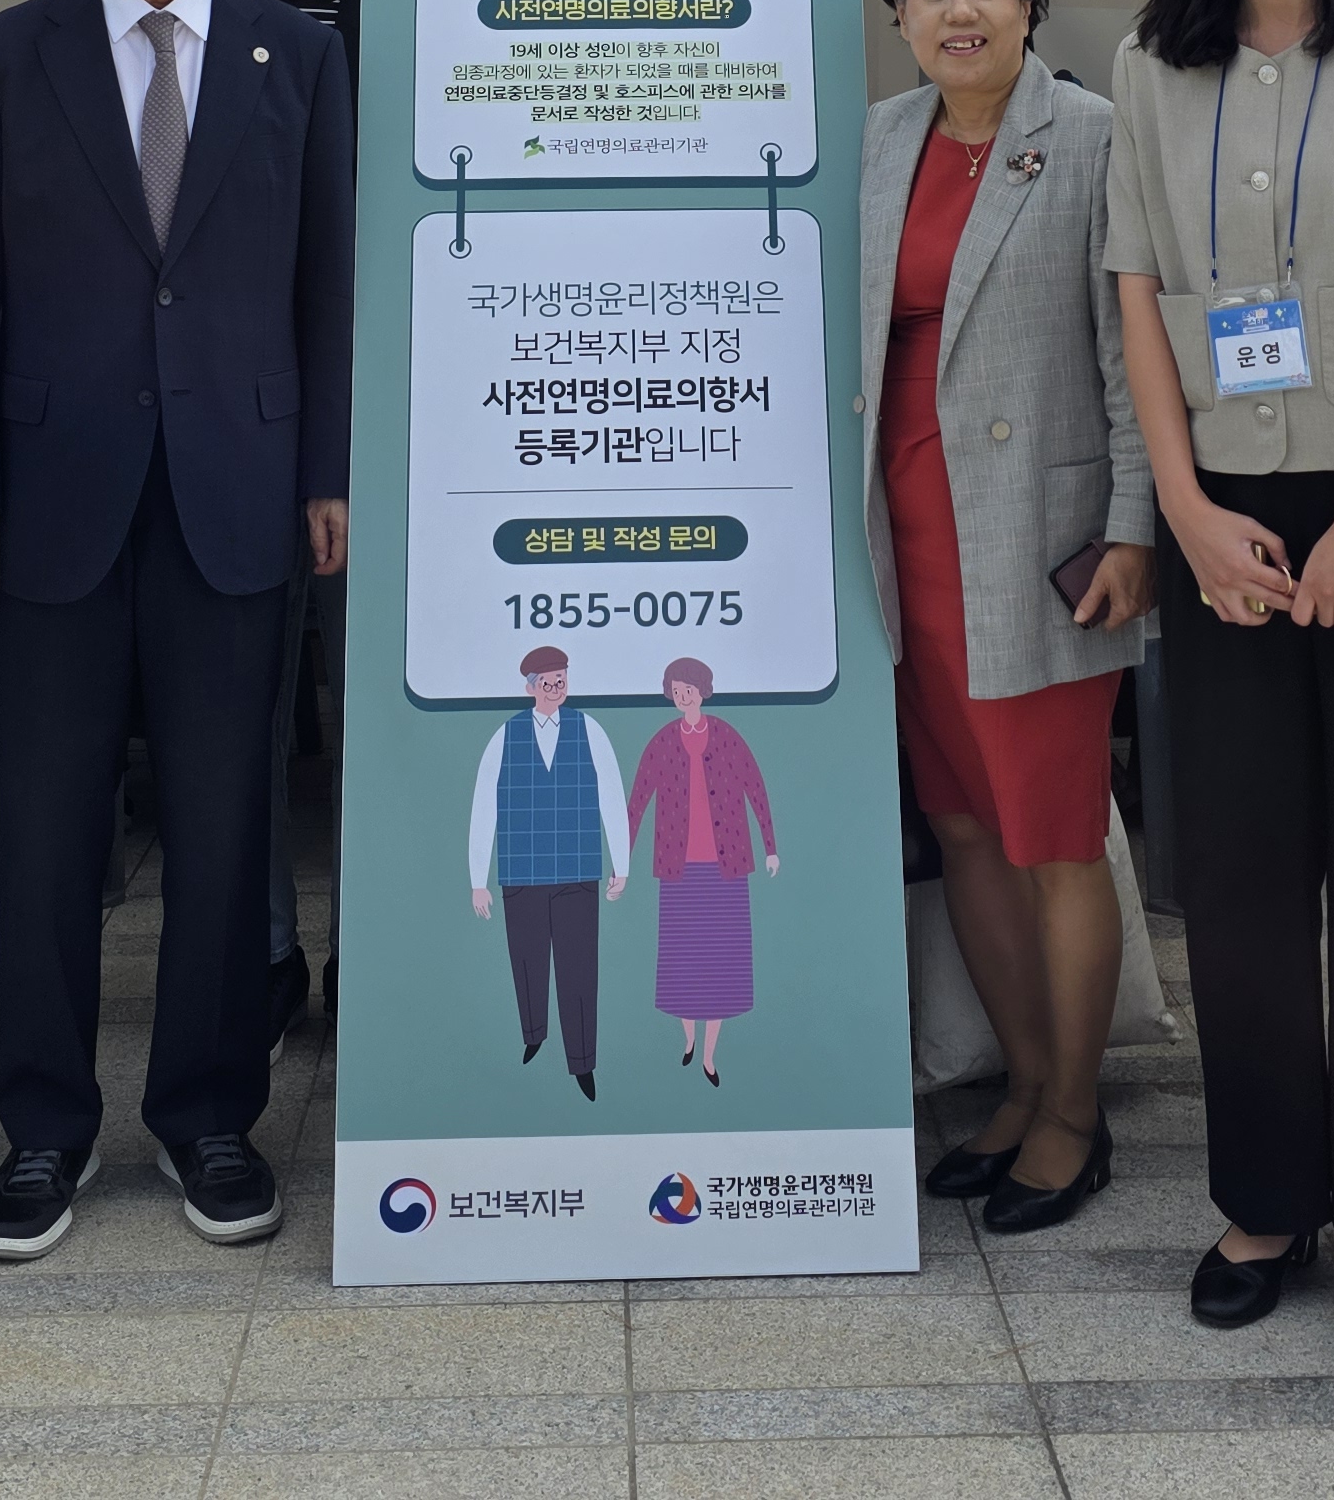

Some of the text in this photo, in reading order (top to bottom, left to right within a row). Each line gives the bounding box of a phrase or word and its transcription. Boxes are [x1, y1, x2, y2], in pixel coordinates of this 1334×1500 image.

[509, 41, 720, 59] 19세 이상 성인이 향후 자신이
[452, 62, 778, 81] 임종과정에 있는 환자가 되었을 때를 대비하여
[444, 83, 787, 102] 연명의료중단등결정 및 호스피스에 관한 의사를
[530, 104, 702, 122] 문서로 작성한 것입니다.
[547, 137, 708, 155] 국립연명의료관리기관
[467, 279, 785, 318] 국가생명윤리정책원은
[510, 327, 742, 366] 보건복지부 지정
[1236, 341, 1281, 369] 운 영
[482, 375, 771, 416] 사전연명의료의향서
[514, 425, 742, 466] 등록기관입니다
[524, 524, 717, 553] 상담 및 작성 문의
[503, 589, 744, 630] 1855-0075
[448, 1173, 875, 1220] 보건복지부 국가생명윤리정책원
[707, 1197, 876, 1220] 국립연명의료관리기관
